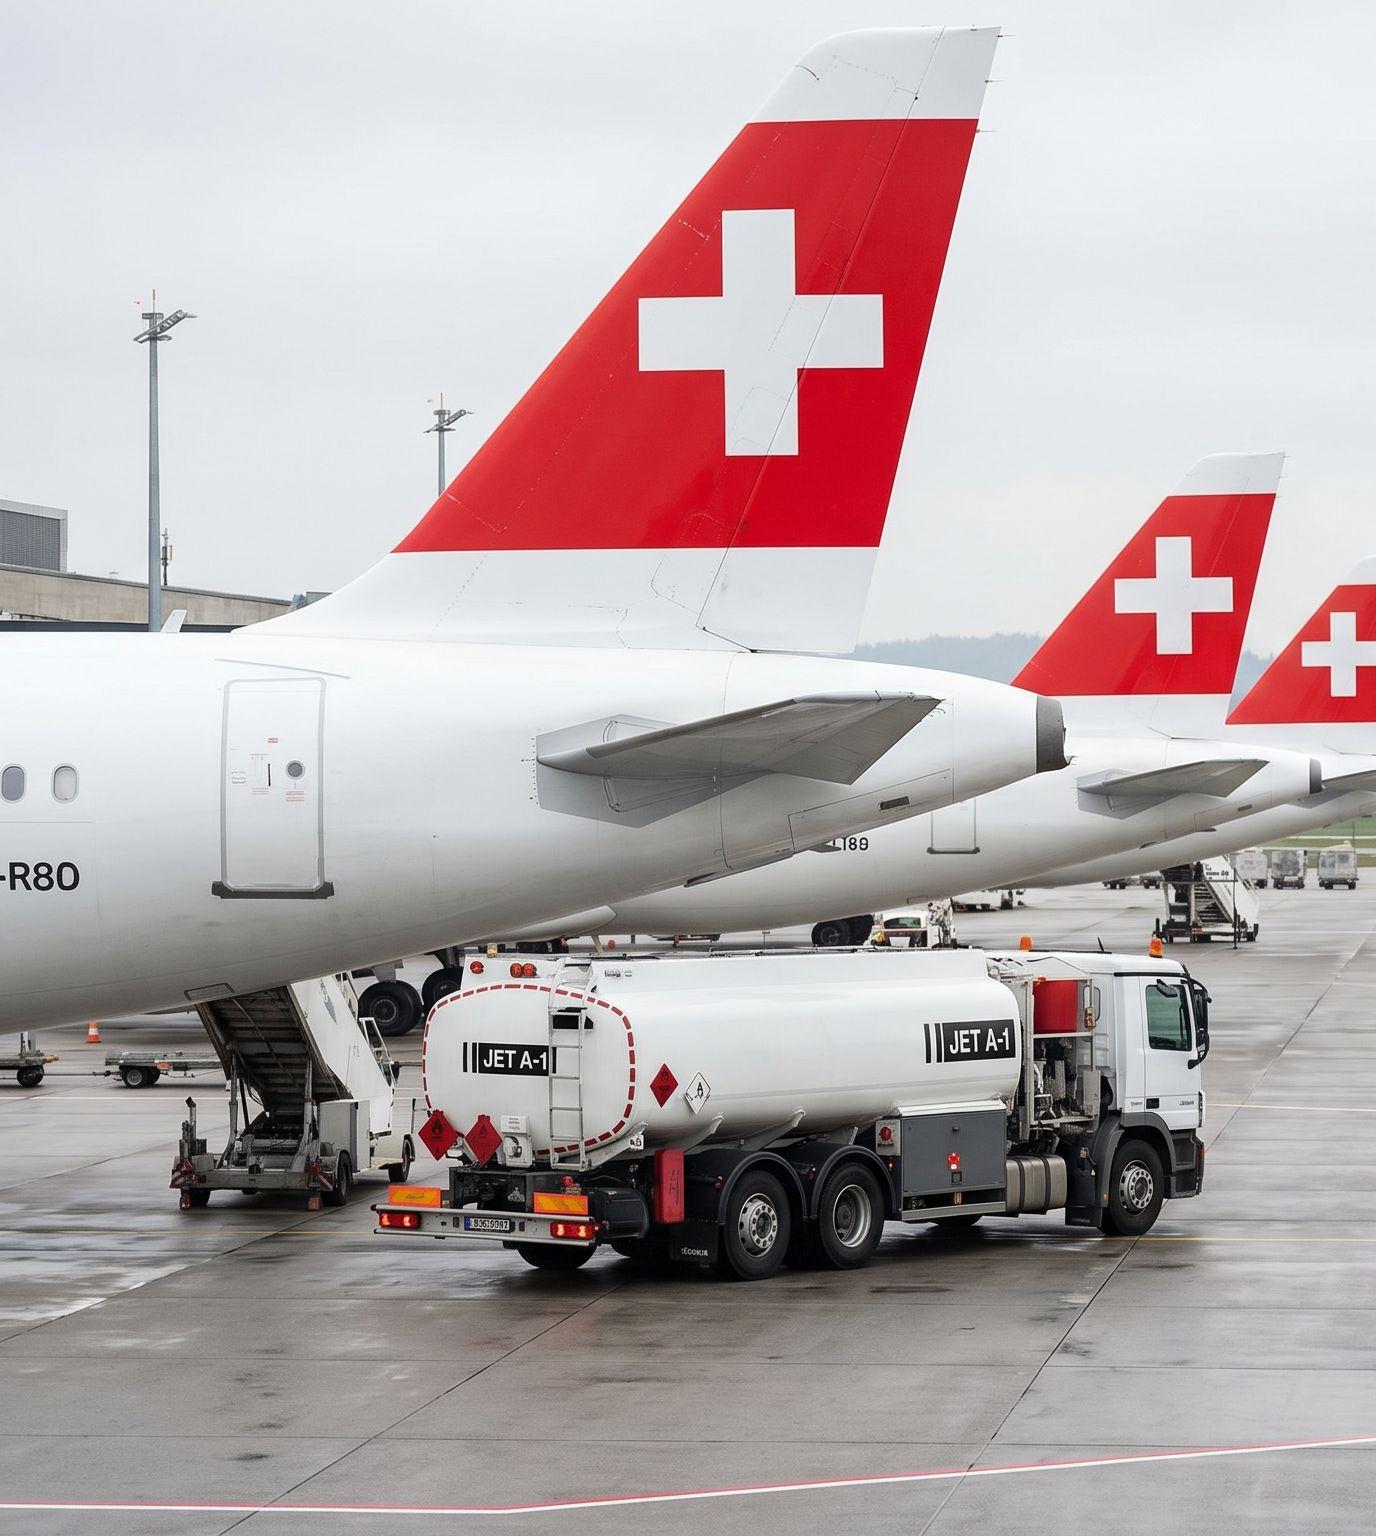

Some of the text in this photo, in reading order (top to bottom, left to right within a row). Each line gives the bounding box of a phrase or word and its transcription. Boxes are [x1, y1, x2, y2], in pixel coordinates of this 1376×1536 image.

[950, 1027, 1010, 1054] JET A-1
[483, 1049, 547, 1070] JET A-1
